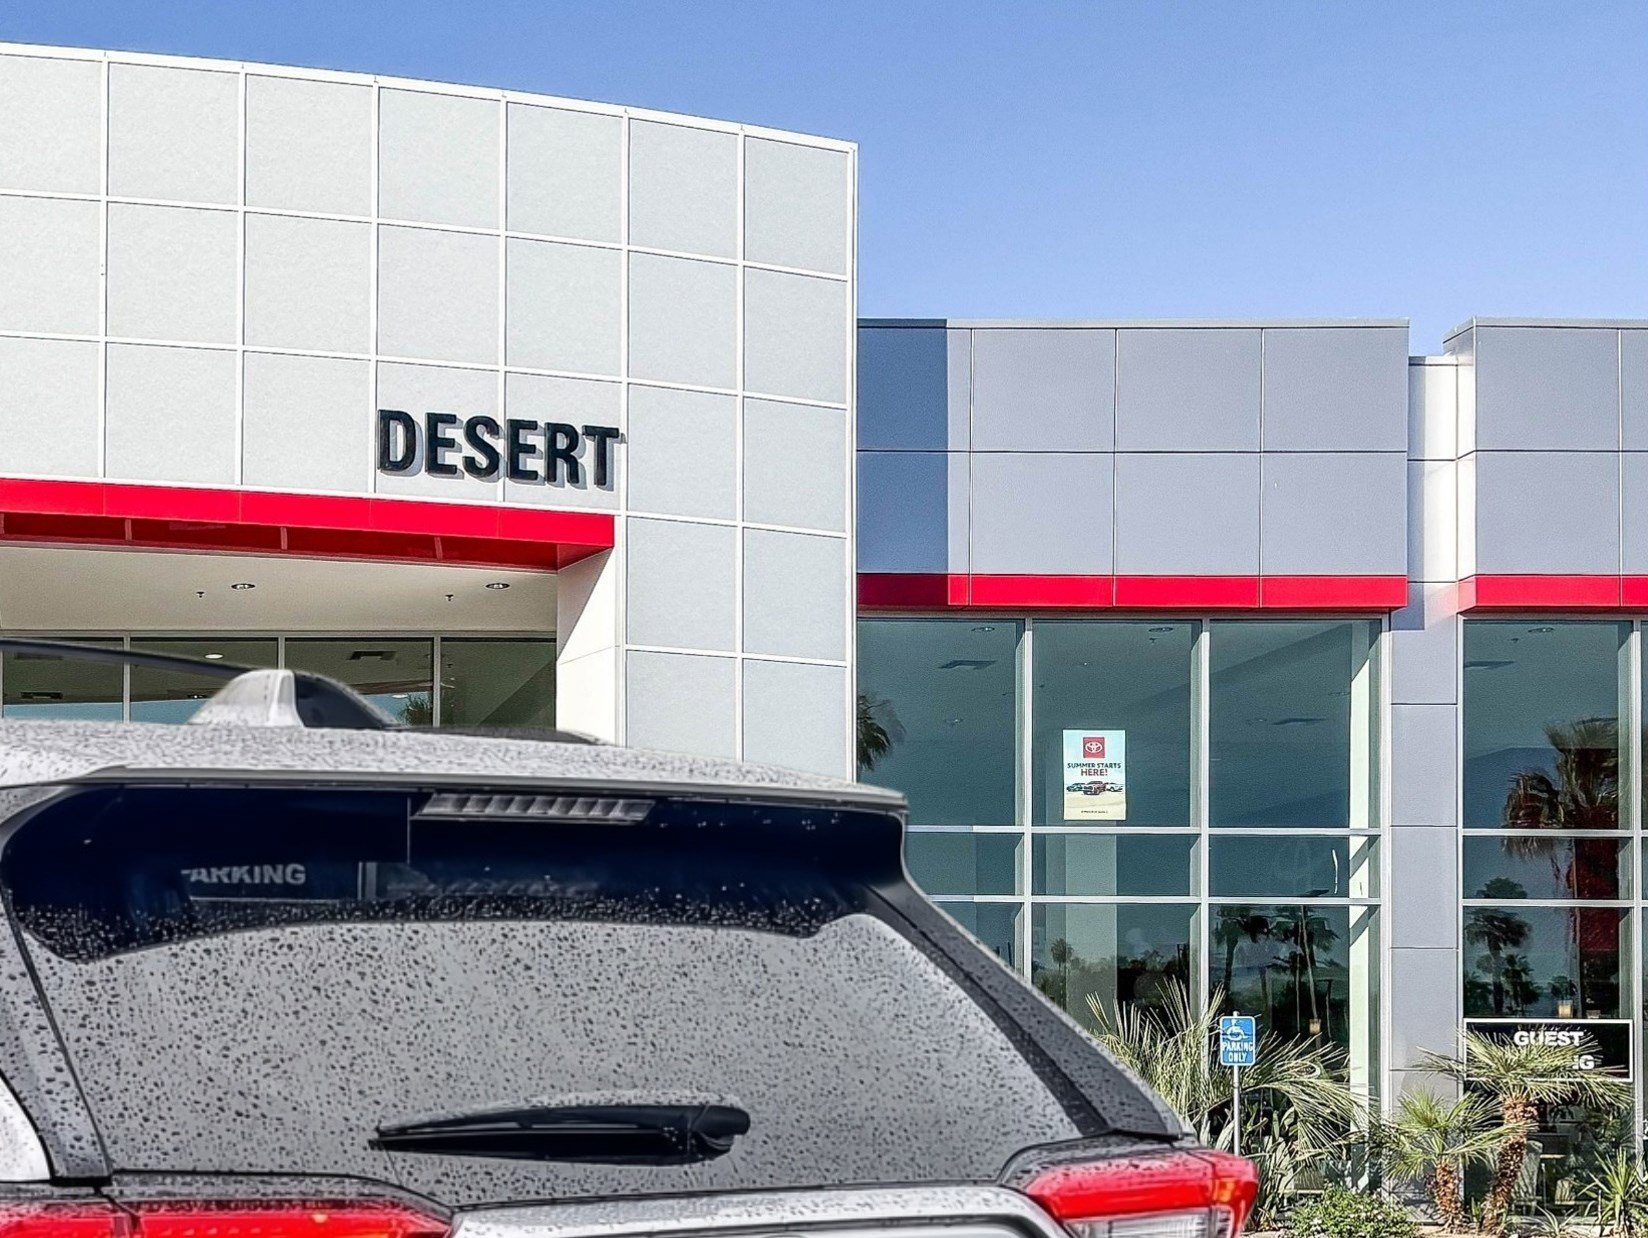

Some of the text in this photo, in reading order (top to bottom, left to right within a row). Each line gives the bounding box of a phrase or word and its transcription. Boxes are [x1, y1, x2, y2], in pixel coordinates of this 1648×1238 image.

[377, 409, 620, 487] DESERT
[1081, 768, 1108, 776] HERE!
[181, 863, 306, 885] ARKING
[1513, 1030, 1584, 1047] GUEST
[1222, 1041, 1253, 1051] PARKING
[1228, 1051, 1247, 1063] ONLY
